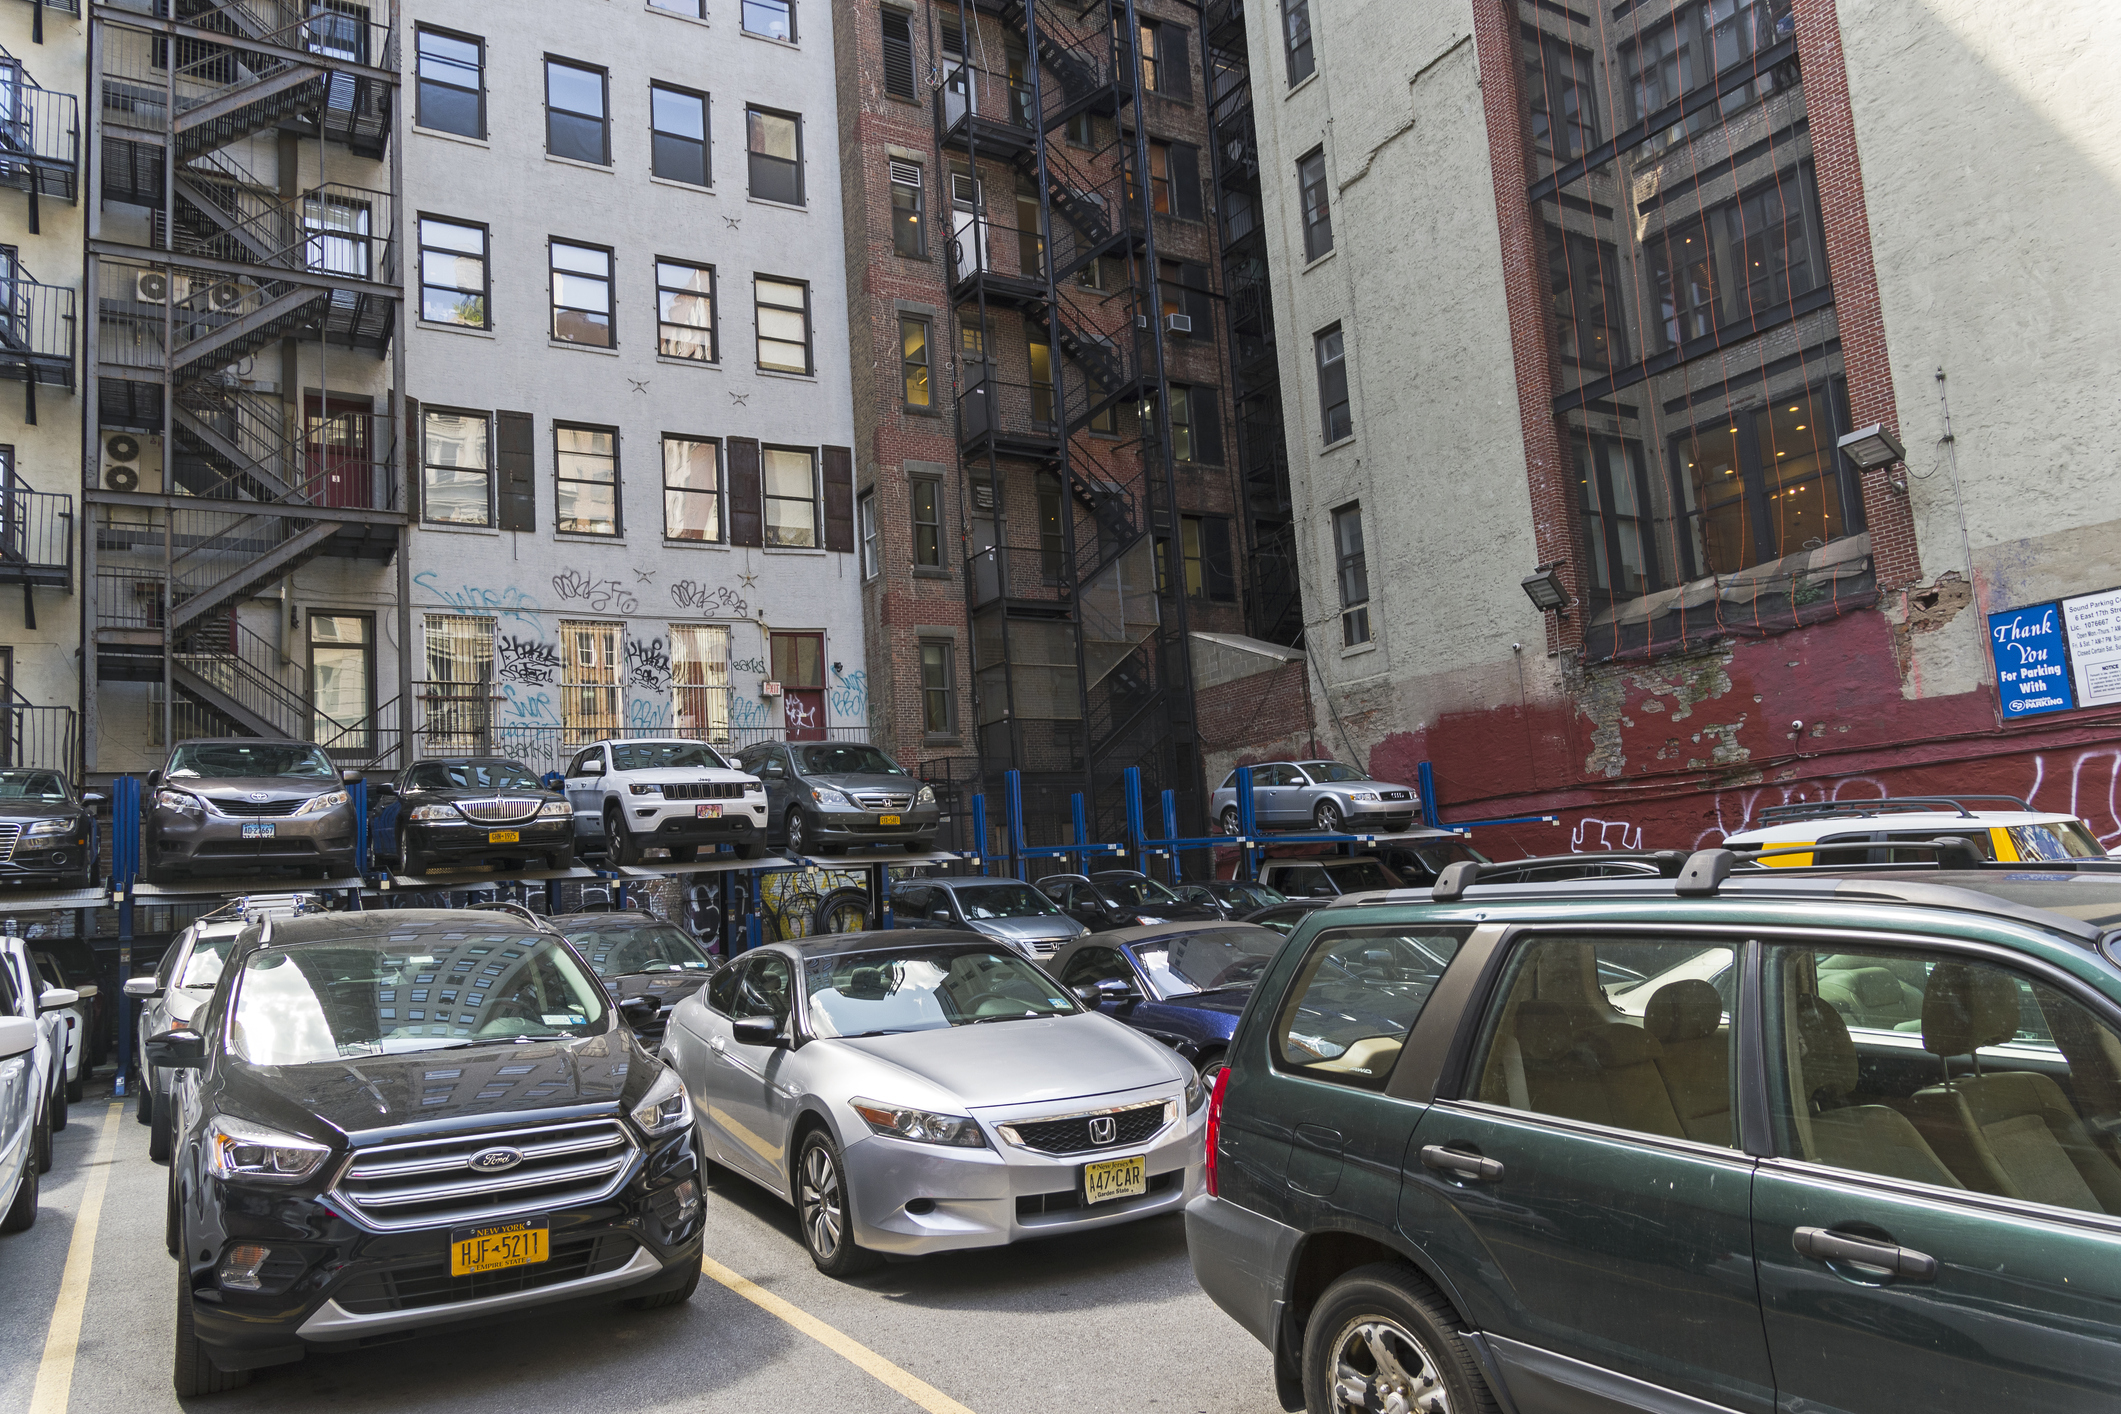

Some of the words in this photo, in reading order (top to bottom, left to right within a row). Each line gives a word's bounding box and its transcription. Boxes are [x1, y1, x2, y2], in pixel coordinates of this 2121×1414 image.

[2069, 604, 2089, 613] Sound
[2090, 600, 2114, 608] Parking
[2080, 612, 2094, 620] East
[1994, 610, 2053, 642] Thank
[2007, 643, 2048, 664] You
[2001, 671, 2017, 682] For
[2020, 664, 2061, 679] Parking
[766, 684, 779, 694] EXIT
[2019, 680, 2047, 694] With
[2025, 698, 2063, 709] PARKING
[1349, 1066, 1372, 1075] AWD
[483, 1153, 510, 1166] Ford
[1111, 1161, 1129, 1170] Jersey
[477, 1227, 499, 1237] NEW
[502, 1223, 525, 1233] YORK
[476, 1261, 504, 1271] EMPIRE
[505, 1257, 525, 1265] STATE
